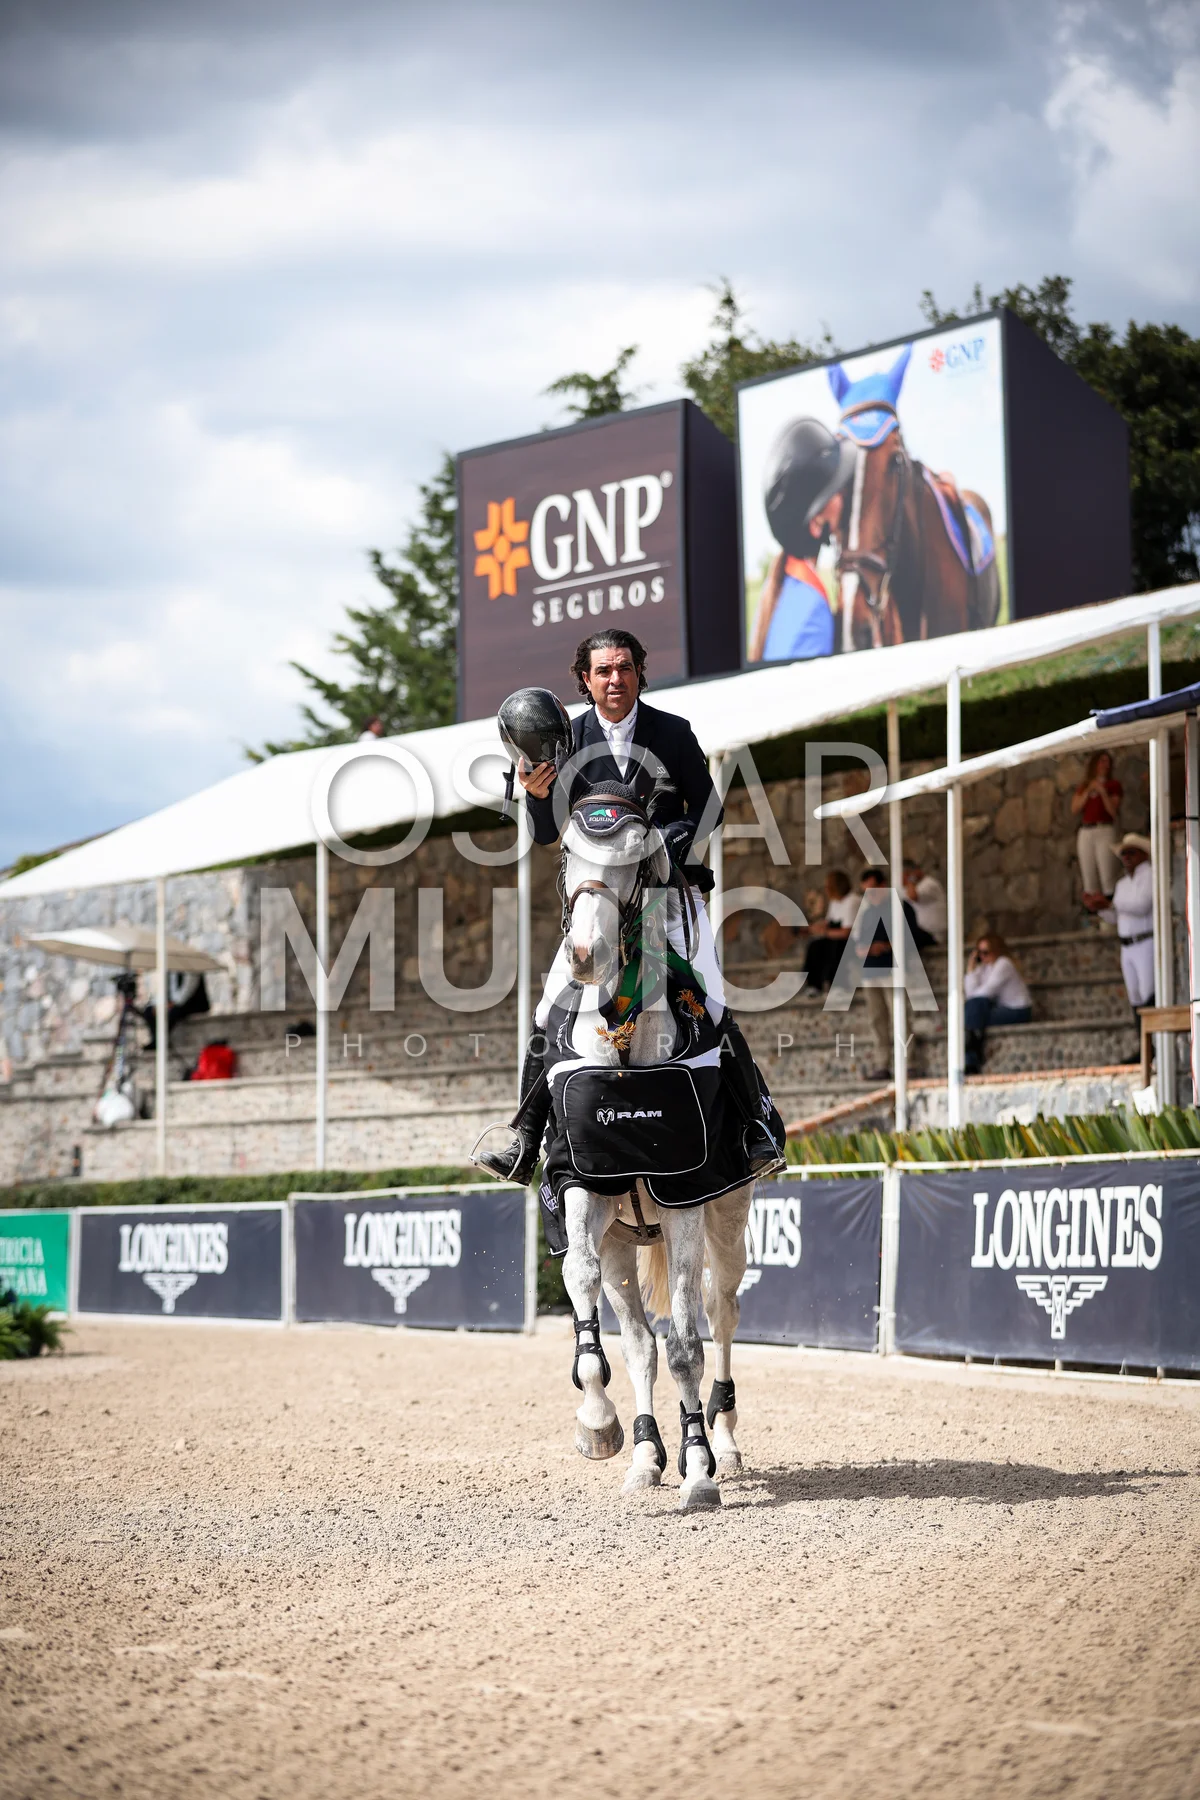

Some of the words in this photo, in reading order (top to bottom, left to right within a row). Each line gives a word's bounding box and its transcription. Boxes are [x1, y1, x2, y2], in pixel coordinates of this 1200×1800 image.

[945, 336, 985, 369] GNP
[532, 577, 665, 627] SEGUROS
[616, 1110, 663, 1119] RAM
[118, 1222, 229, 1275] LONGINES
[343, 1209, 463, 1268] LONGINES
[972, 1183, 1164, 1271] LONGINES
